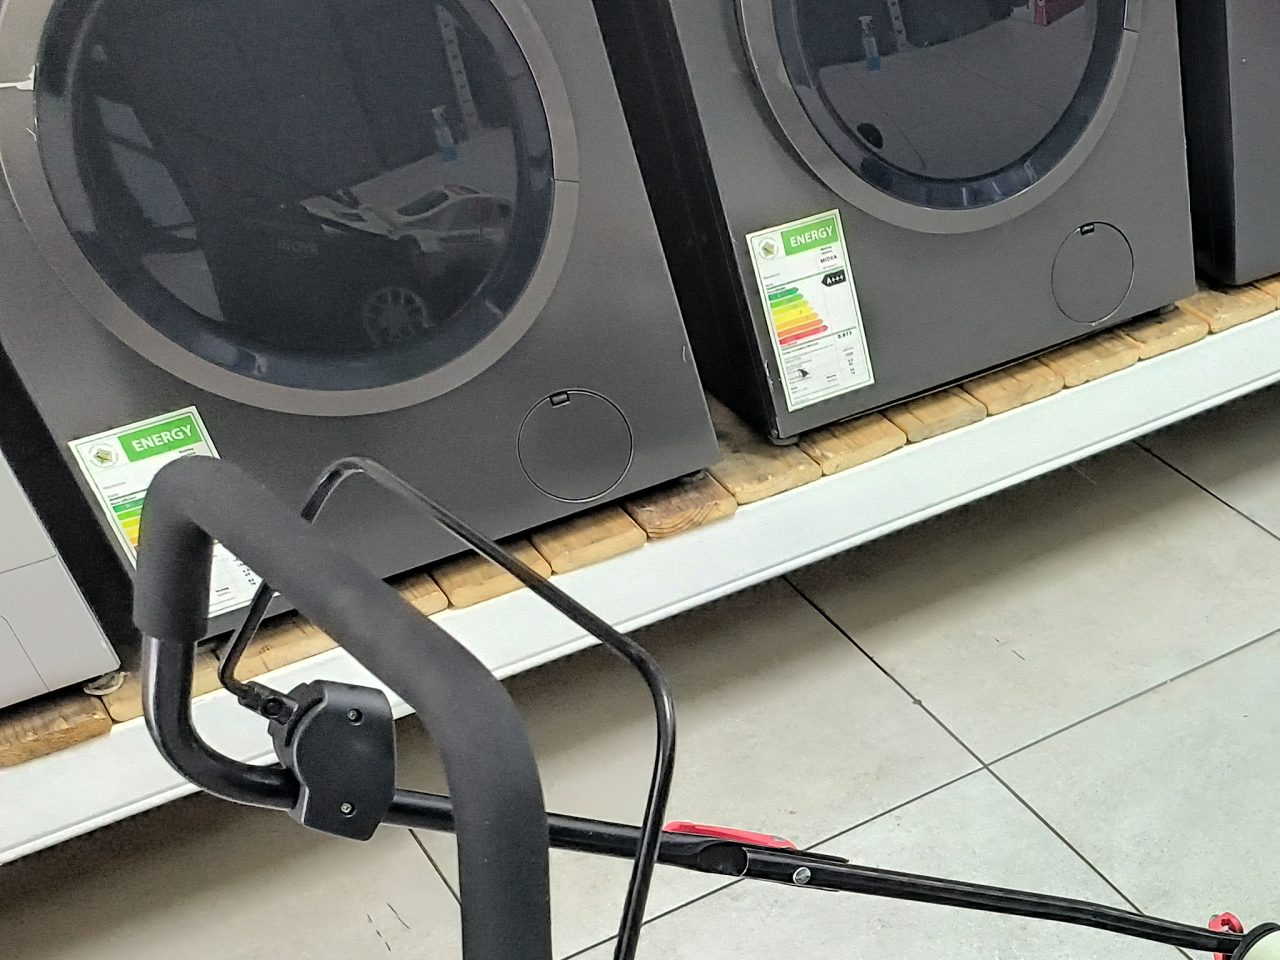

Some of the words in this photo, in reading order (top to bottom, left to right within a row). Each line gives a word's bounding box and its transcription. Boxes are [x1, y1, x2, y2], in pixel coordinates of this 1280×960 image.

[790, 226, 833, 247] ENERGY
[826, 273, 844, 285] A+++
[132, 424, 193, 451] ENERGY
